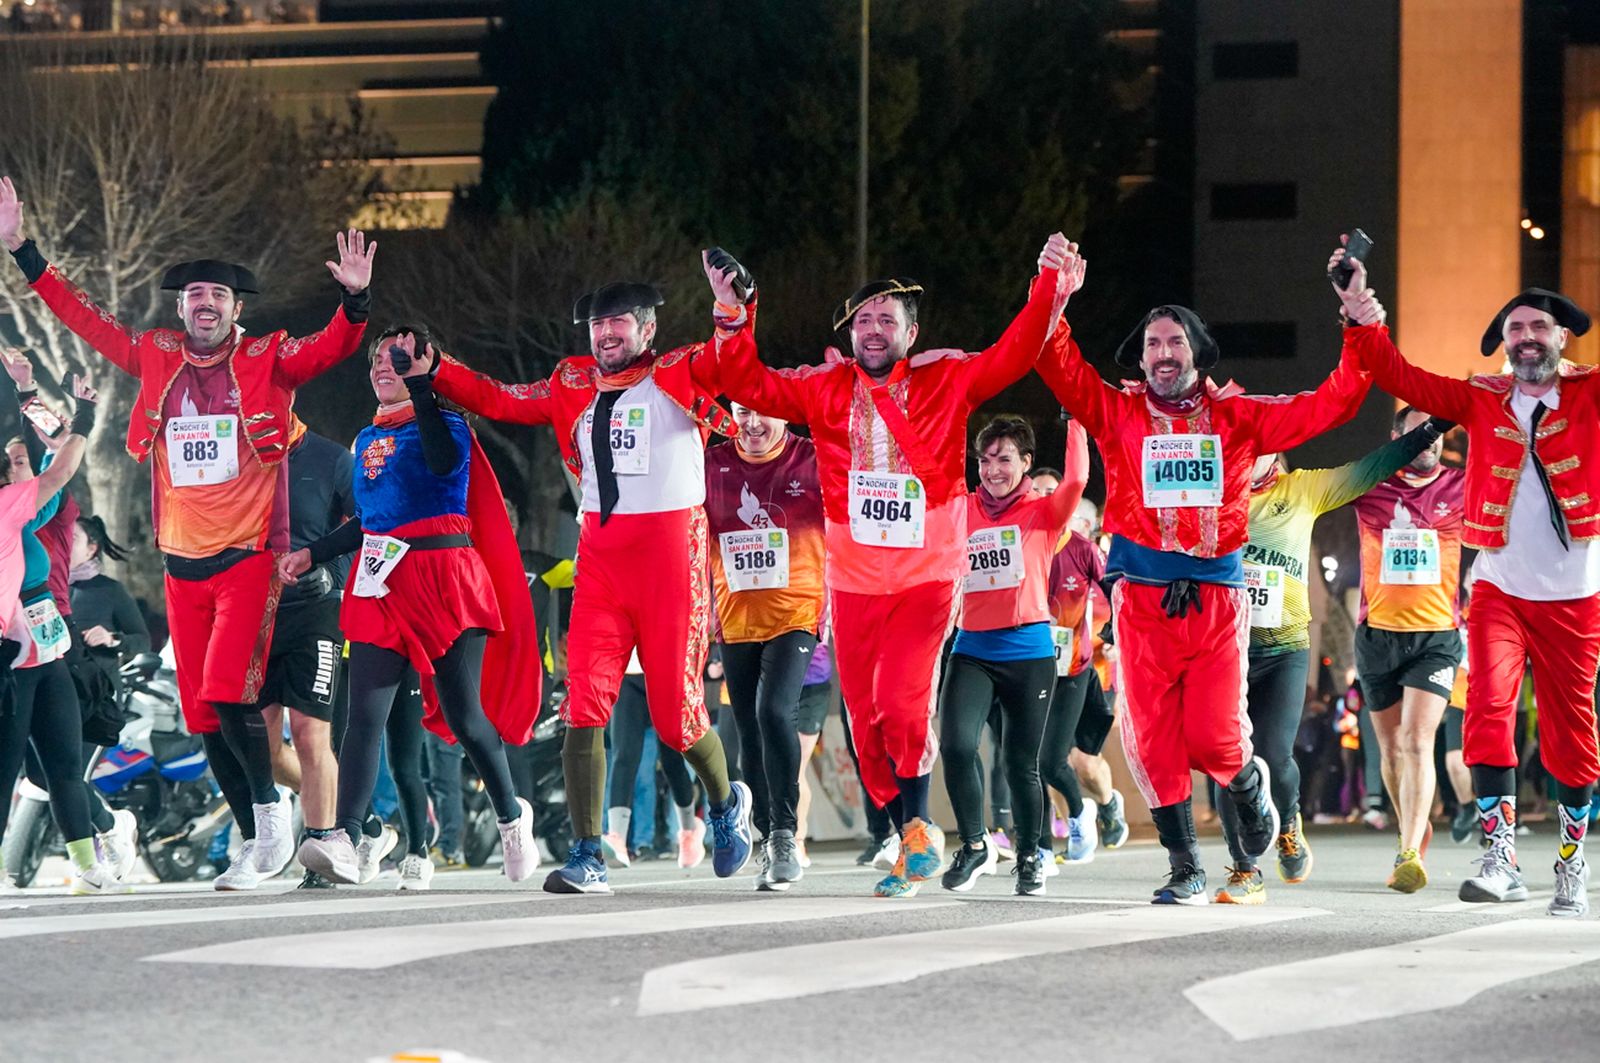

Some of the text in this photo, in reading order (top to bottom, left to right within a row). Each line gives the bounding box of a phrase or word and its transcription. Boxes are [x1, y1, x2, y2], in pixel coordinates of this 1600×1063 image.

[611, 429, 635, 449] 35
[1159, 442, 1182, 450] NOCHE
[1184, 442, 1193, 450] DE
[183, 440, 218, 461] 883
[362, 444, 396, 458] POWER
[1151, 451, 1166, 460] SAN
[364, 456, 385, 467] GIRL
[367, 467, 378, 479] S
[1152, 460, 1214, 482] 14035
[856, 488, 870, 496] SAN
[865, 480, 887, 488] NOCHE
[861, 498, 911, 522] 4964
[751, 514, 768, 529] 43
[728, 545, 740, 553] SAN
[1393, 549, 1427, 565] 8134
[734, 550, 776, 570] 5188
[968, 548, 1011, 571] 2889
[1243, 544, 1302, 580] PANDERA
[1247, 587, 1269, 606] 35
[312, 640, 333, 696] PUMA
